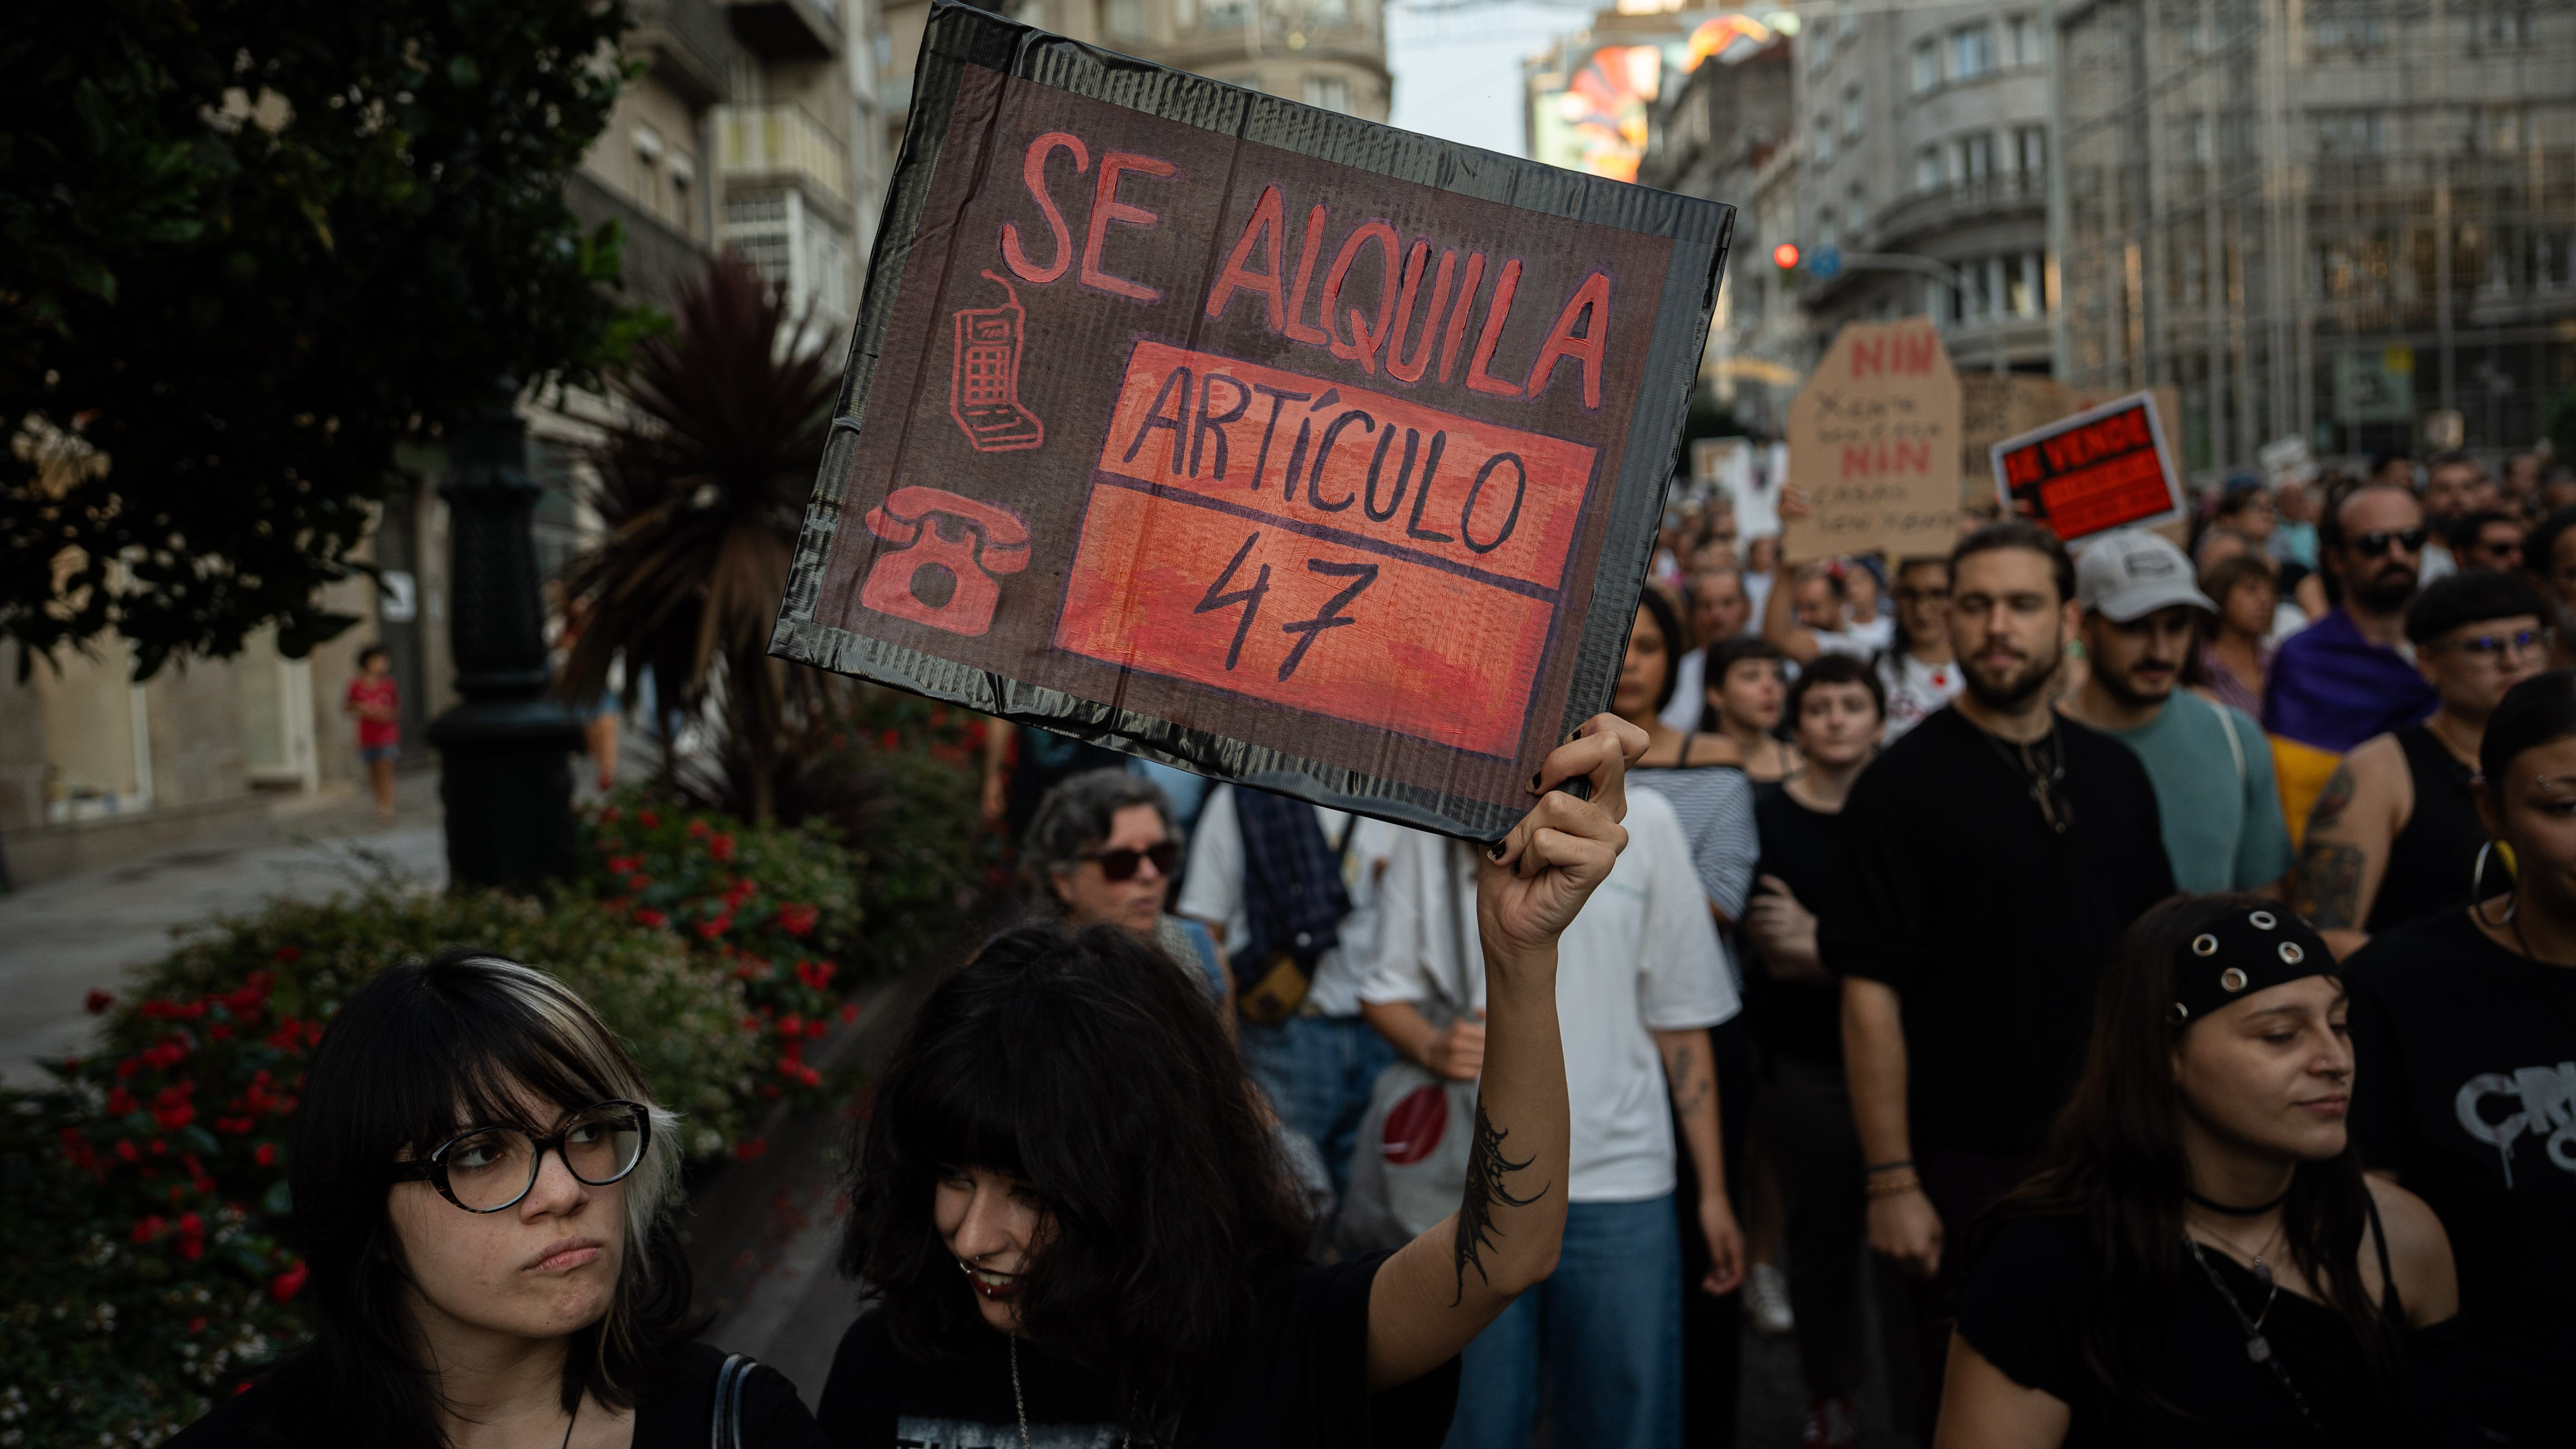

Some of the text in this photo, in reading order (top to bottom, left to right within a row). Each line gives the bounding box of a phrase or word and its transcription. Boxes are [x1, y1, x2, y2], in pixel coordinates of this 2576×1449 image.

[1000, 132, 1610, 410] SE ALQUILA
[1851, 329, 1935, 378] NIN
[1124, 366, 1526, 555] ARTÍCULO
[2044, 406, 2149, 471] VENDE
[1195, 531, 1380, 682] 47
